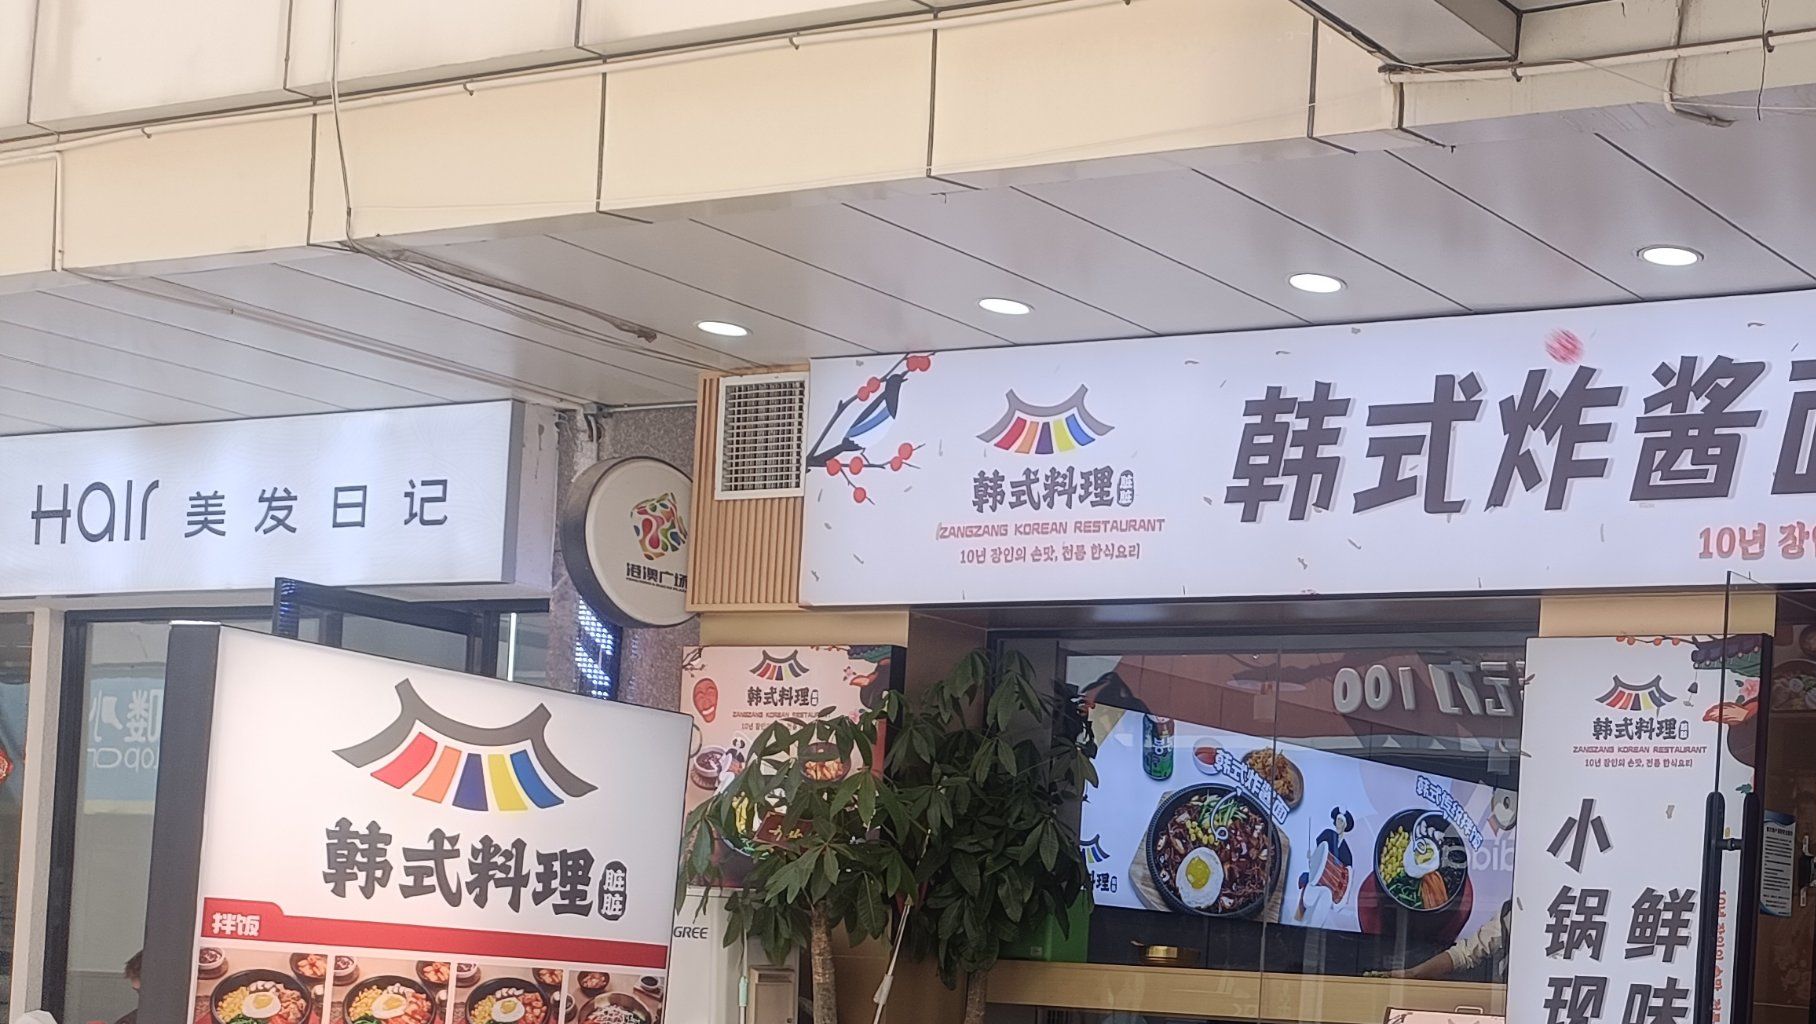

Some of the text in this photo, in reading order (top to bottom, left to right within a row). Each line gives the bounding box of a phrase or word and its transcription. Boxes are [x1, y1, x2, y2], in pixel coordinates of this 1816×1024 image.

[972, 465, 1114, 514] 韩式料理
[184, 478, 449, 539] 美发日记
[939, 518, 1165, 539] ZANGZANG KOREAN RESTAURANT
[960, 549, 986, 564] 10년
[991, 546, 1026, 563] 장인의
[1091, 542, 1140, 560] 한식요리
[1699, 522, 1767, 560] 10년
[747, 686, 809, 706] 韩式料理
[1593, 717, 1677, 740] 韩式料理
[1618, 746, 1649, 754] KOREAN
[1653, 745, 1707, 754] RESTAURANT
[1213, 747, 1291, 826] 韩式炸酱面
[322, 817, 595, 917] 韩式料理
[212, 912, 261, 937] 拌饭
[672, 926, 709, 940] GREE
